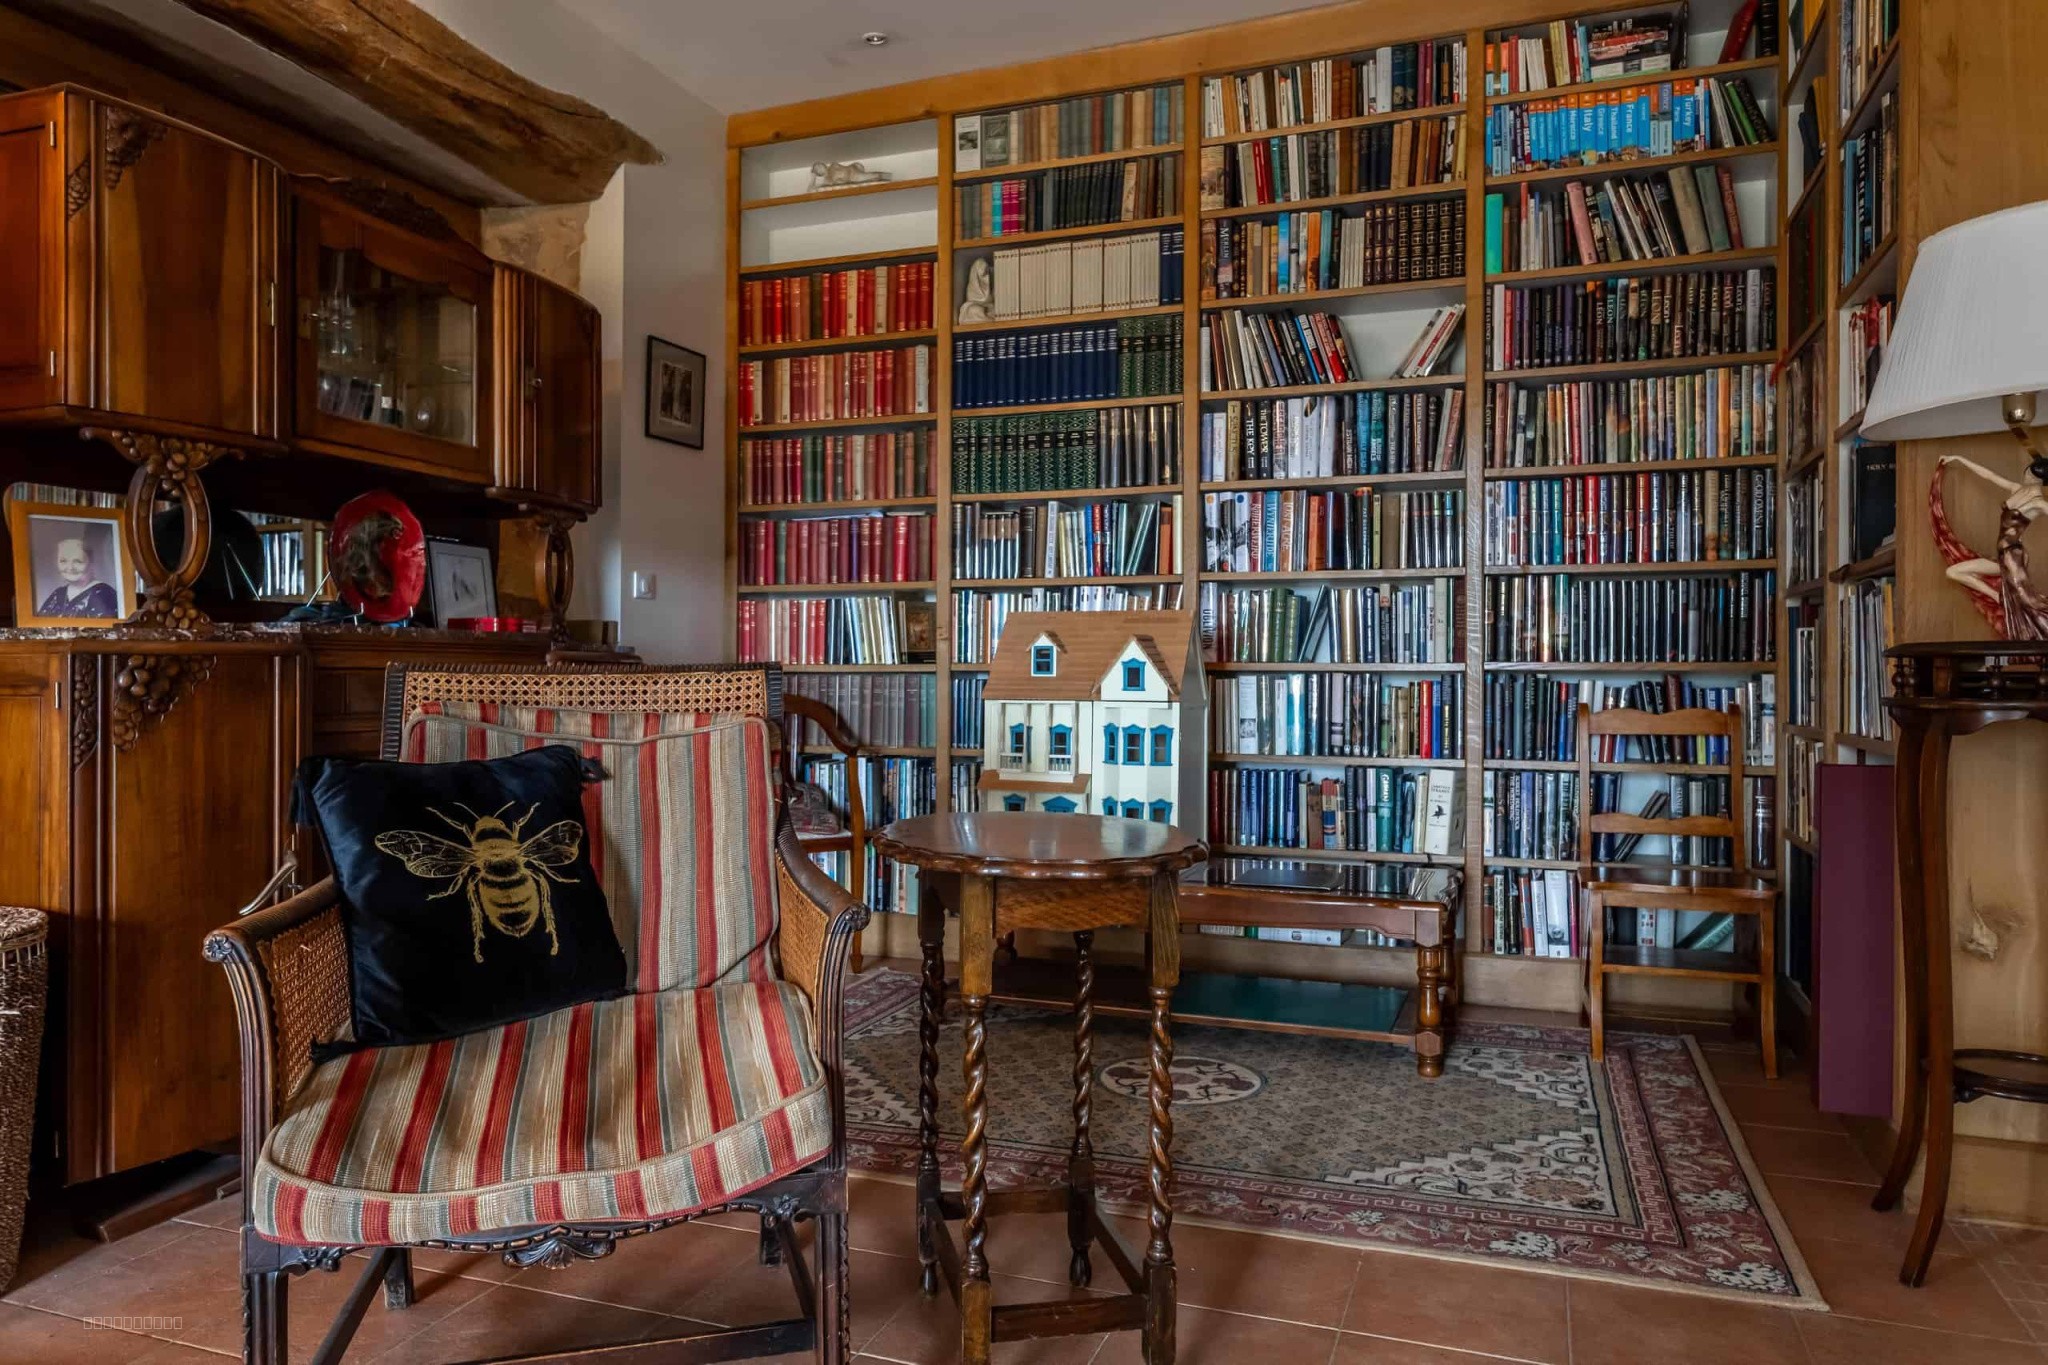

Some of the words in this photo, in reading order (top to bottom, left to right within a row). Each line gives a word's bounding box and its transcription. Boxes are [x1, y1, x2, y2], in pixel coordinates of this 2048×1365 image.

[1582, 109, 1593, 132] Italy
[1626, 104, 1634, 133] France
[1683, 96, 1693, 127] Turkey
[1569, 110, 1577, 140] Morocco
[1219, 227, 1229, 258] MERLIN
[1651, 289, 1661, 322] LEON
[1664, 295, 1672, 318] Leon
[1674, 325, 1683, 349] Leon
[1246, 418, 1254, 436] THE
[1485, 404, 1493, 425] Leon
[1246, 438, 1255, 455] KEY
[1260, 421, 1268, 453] TOWER
[1755, 474, 1763, 498] GOOD
[1283, 525, 1291, 550] ACRE
[1203, 609, 1213, 650] OBLIVION
